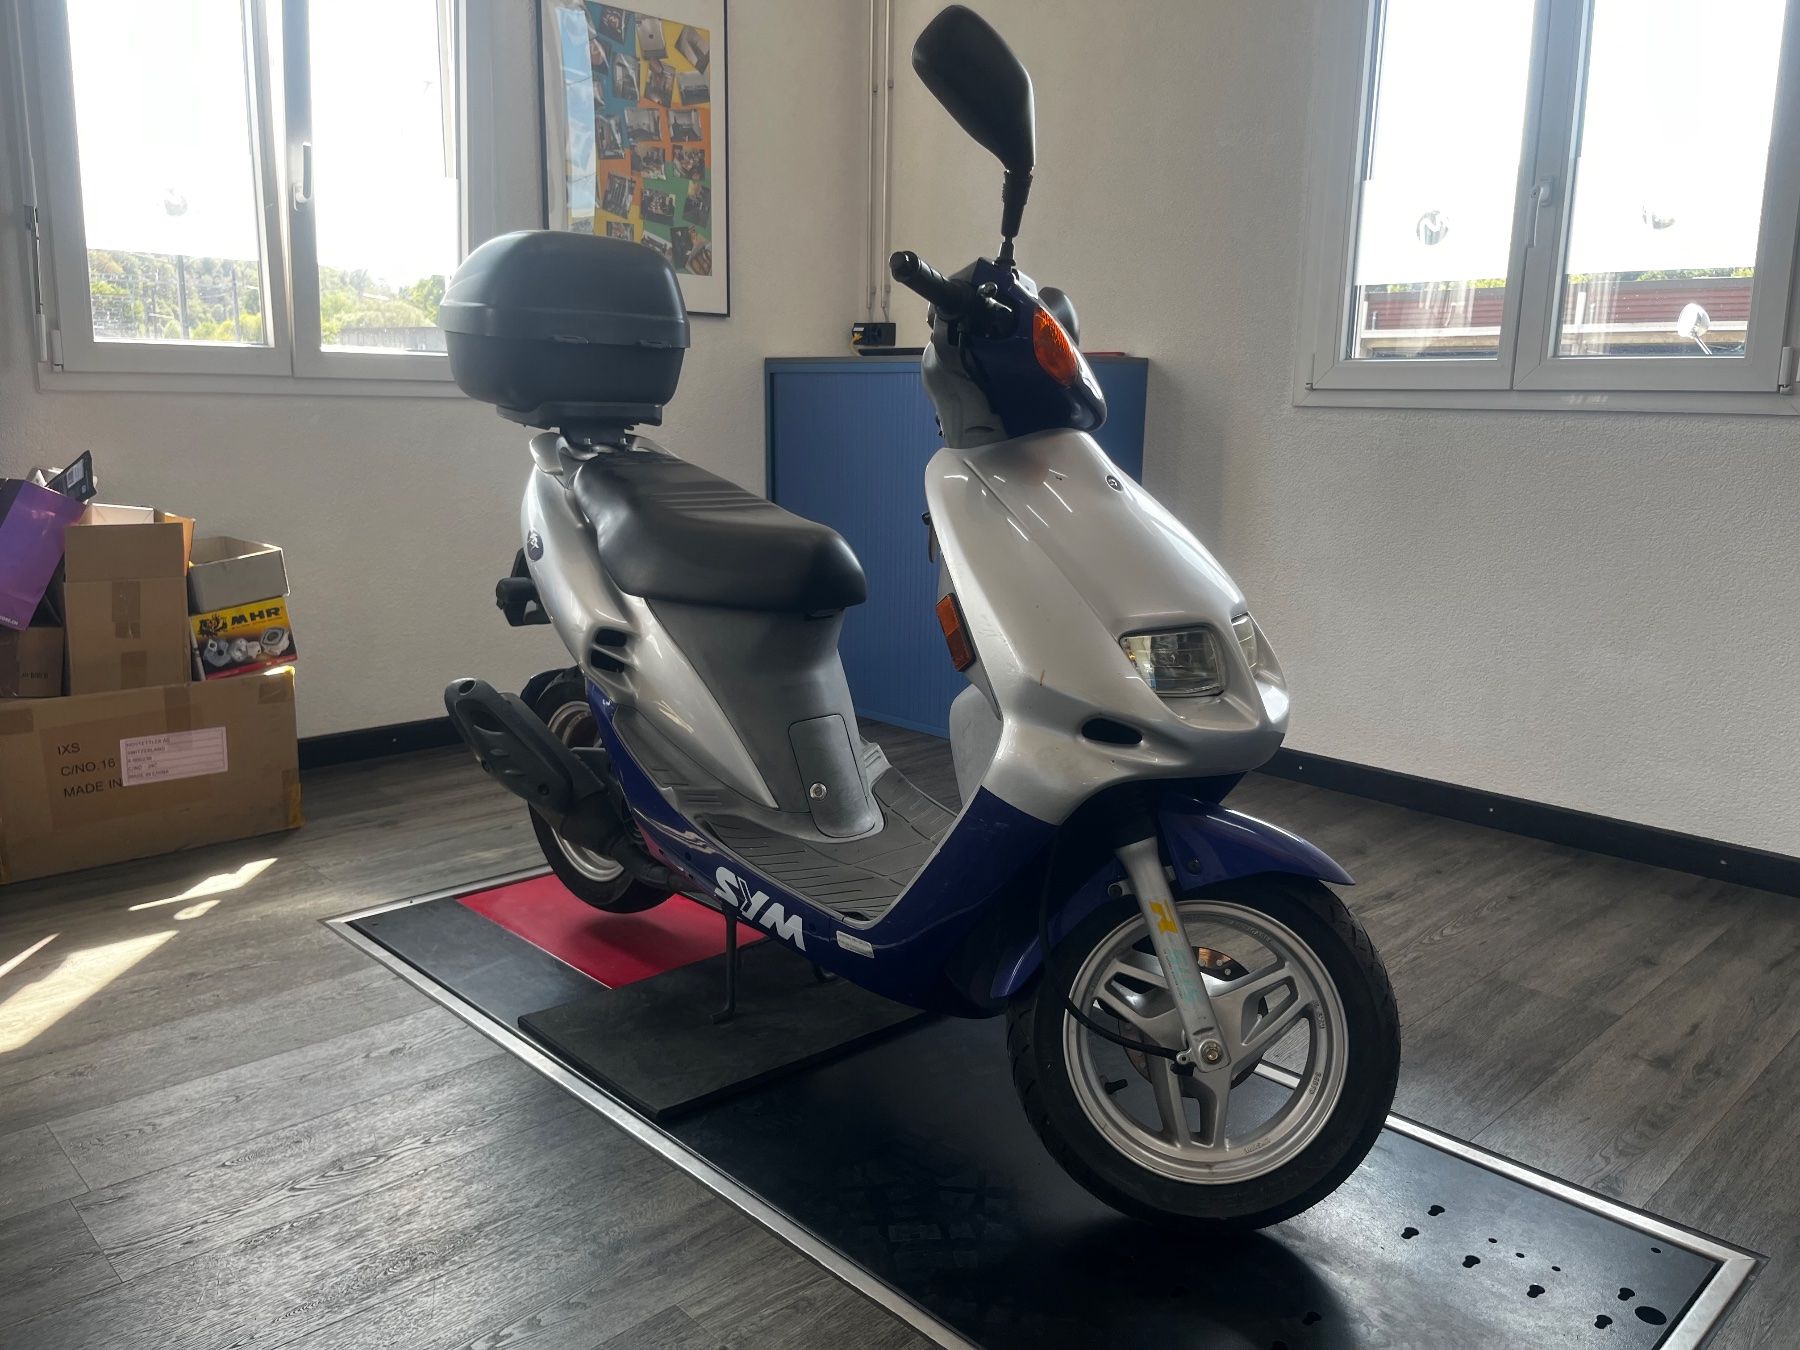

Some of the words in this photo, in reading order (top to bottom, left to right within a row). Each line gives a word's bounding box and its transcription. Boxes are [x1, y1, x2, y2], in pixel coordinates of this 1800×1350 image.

[231, 607, 281, 626] MHR
[57, 742, 80, 756] IXS
[63, 780, 104, 798] MADE
[109, 778, 122, 789] IN
[714, 866, 806, 952] SYM
